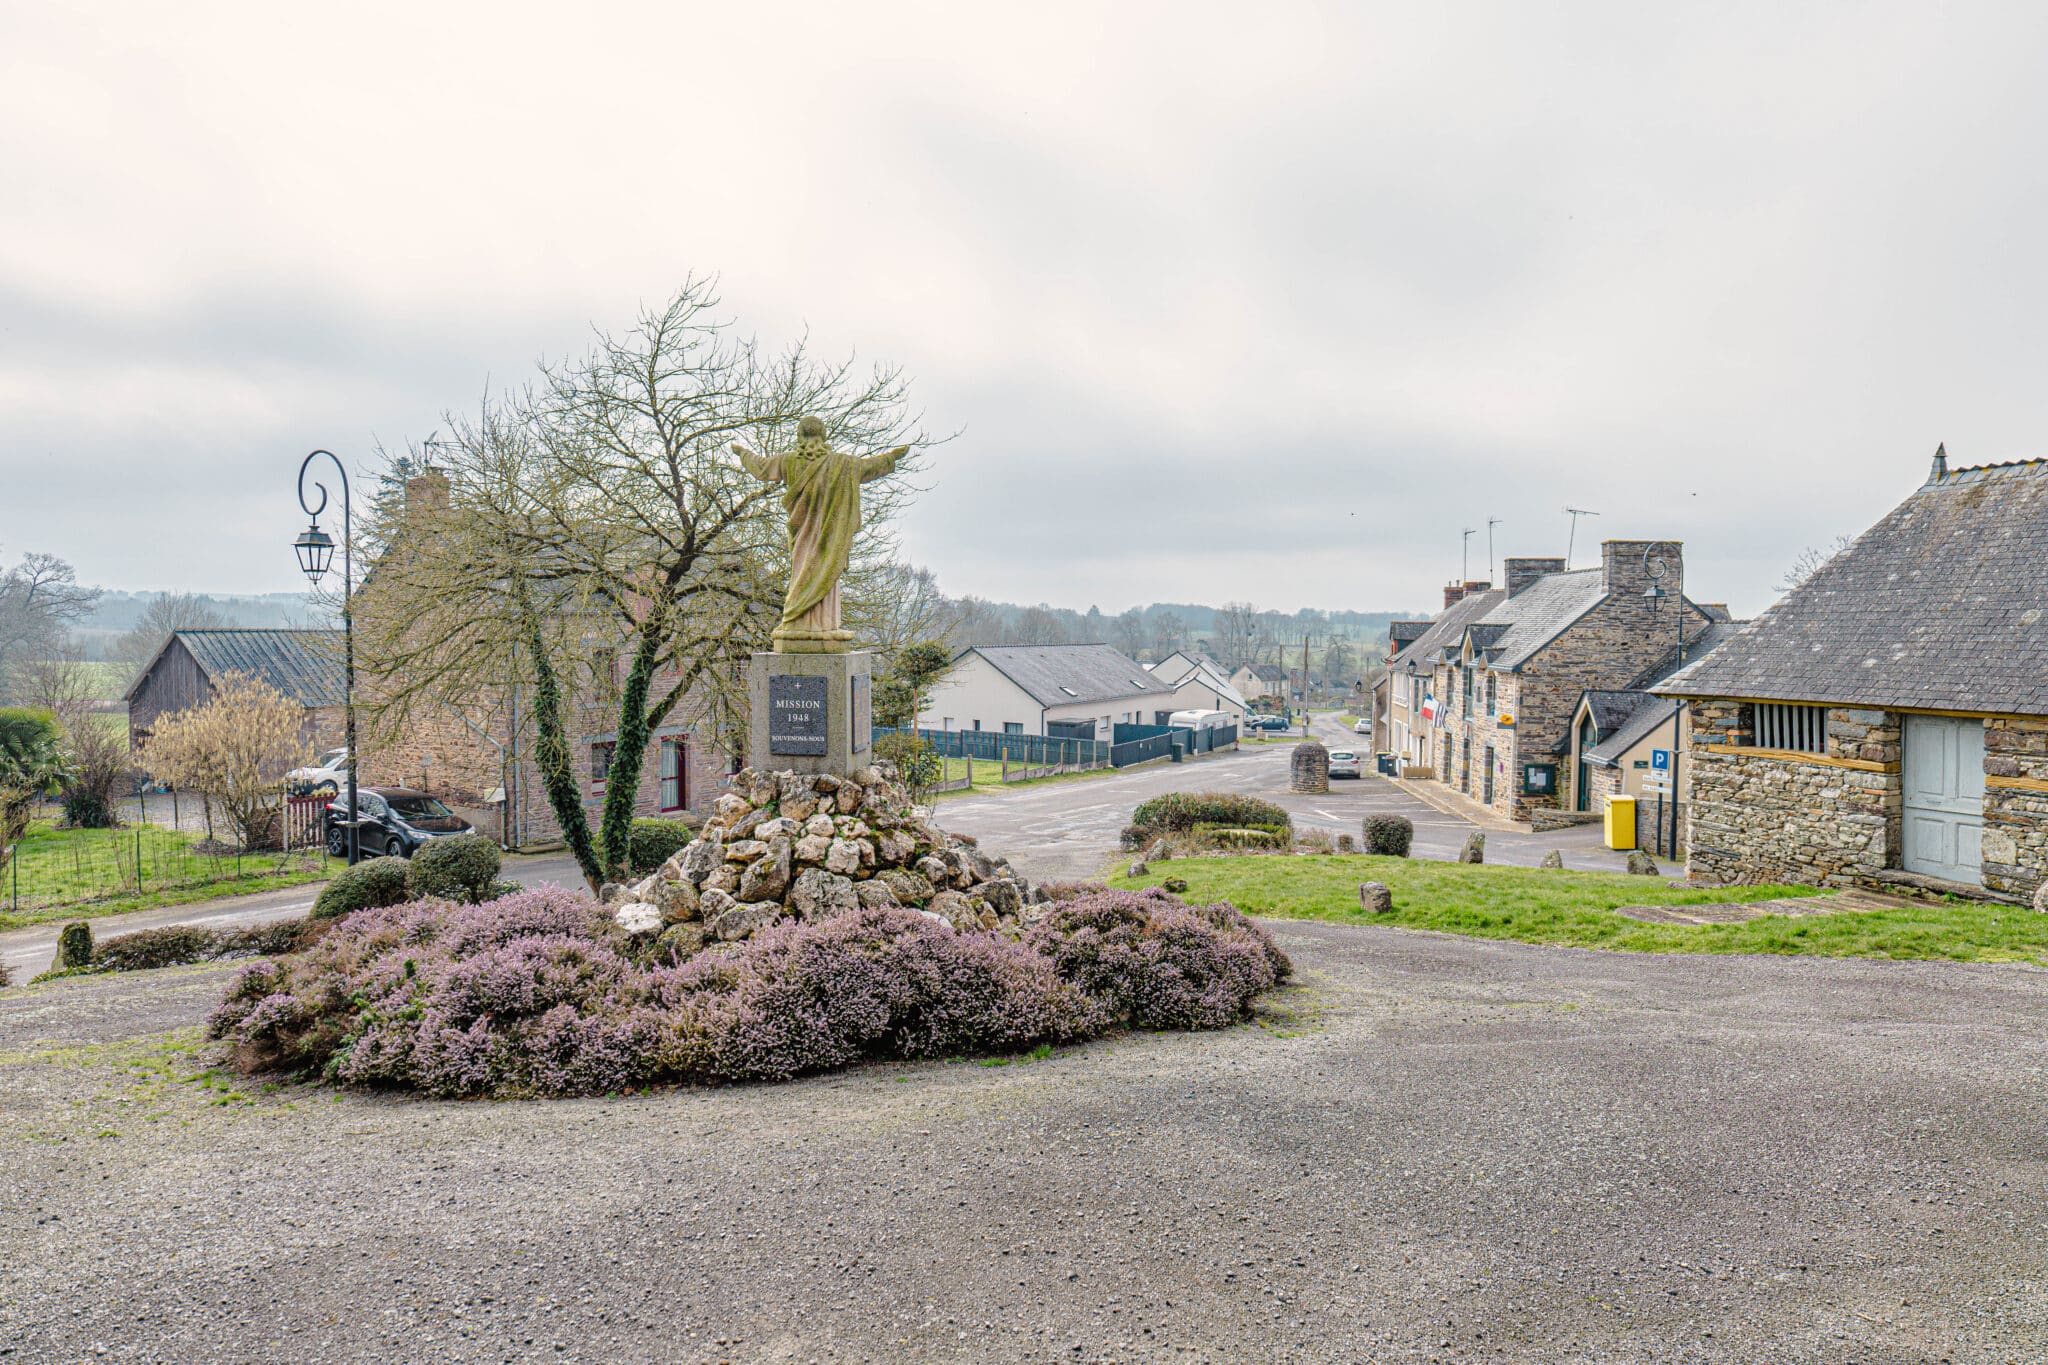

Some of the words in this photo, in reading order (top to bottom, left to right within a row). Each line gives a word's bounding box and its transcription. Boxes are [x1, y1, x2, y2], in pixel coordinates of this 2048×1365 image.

[776, 700, 820, 709] MISSION
[788, 713, 809, 722] 1948
[1656, 753, 1664, 766] P
